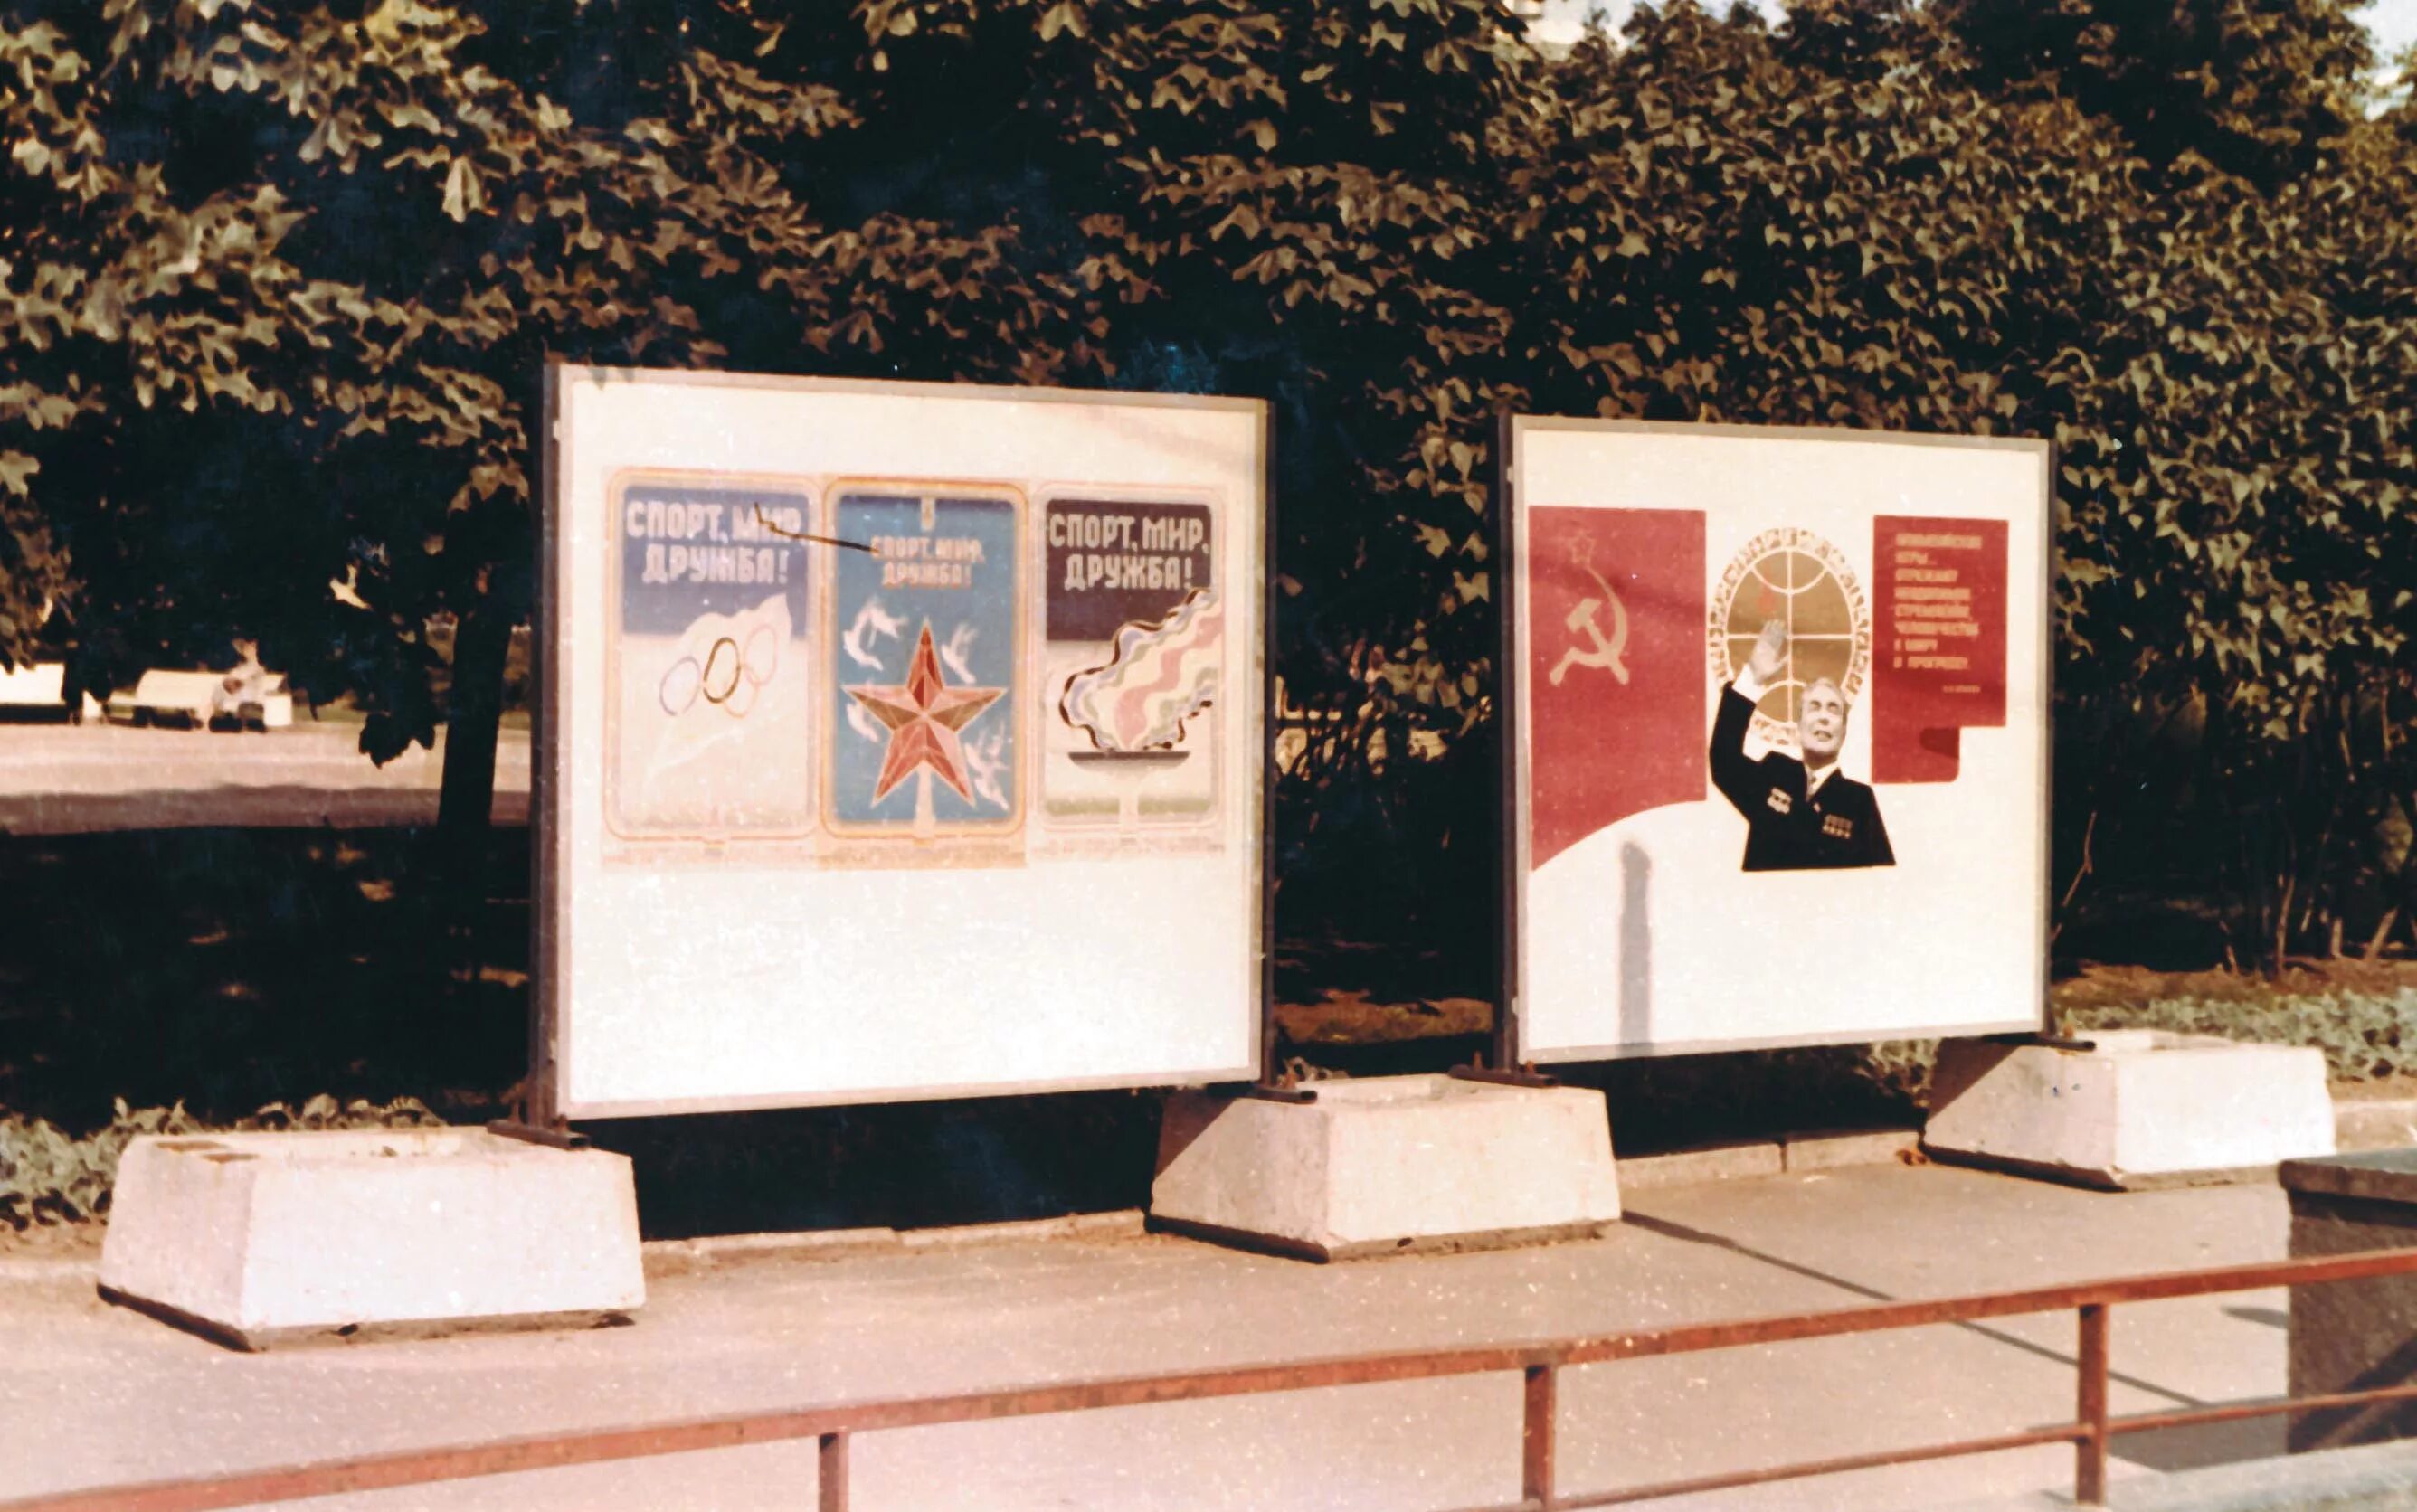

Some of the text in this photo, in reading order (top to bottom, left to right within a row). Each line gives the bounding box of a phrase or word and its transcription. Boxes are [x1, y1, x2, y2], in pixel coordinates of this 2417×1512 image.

[626, 500, 729, 543] СПОРТ,
[1049, 513, 1210, 555] СПОРТ, МИР,
[641, 543, 791, 584] ДРУЖБА!
[882, 562, 972, 589] ДРУЖБА!
[1064, 553, 1193, 591] ДРУЖБА!
